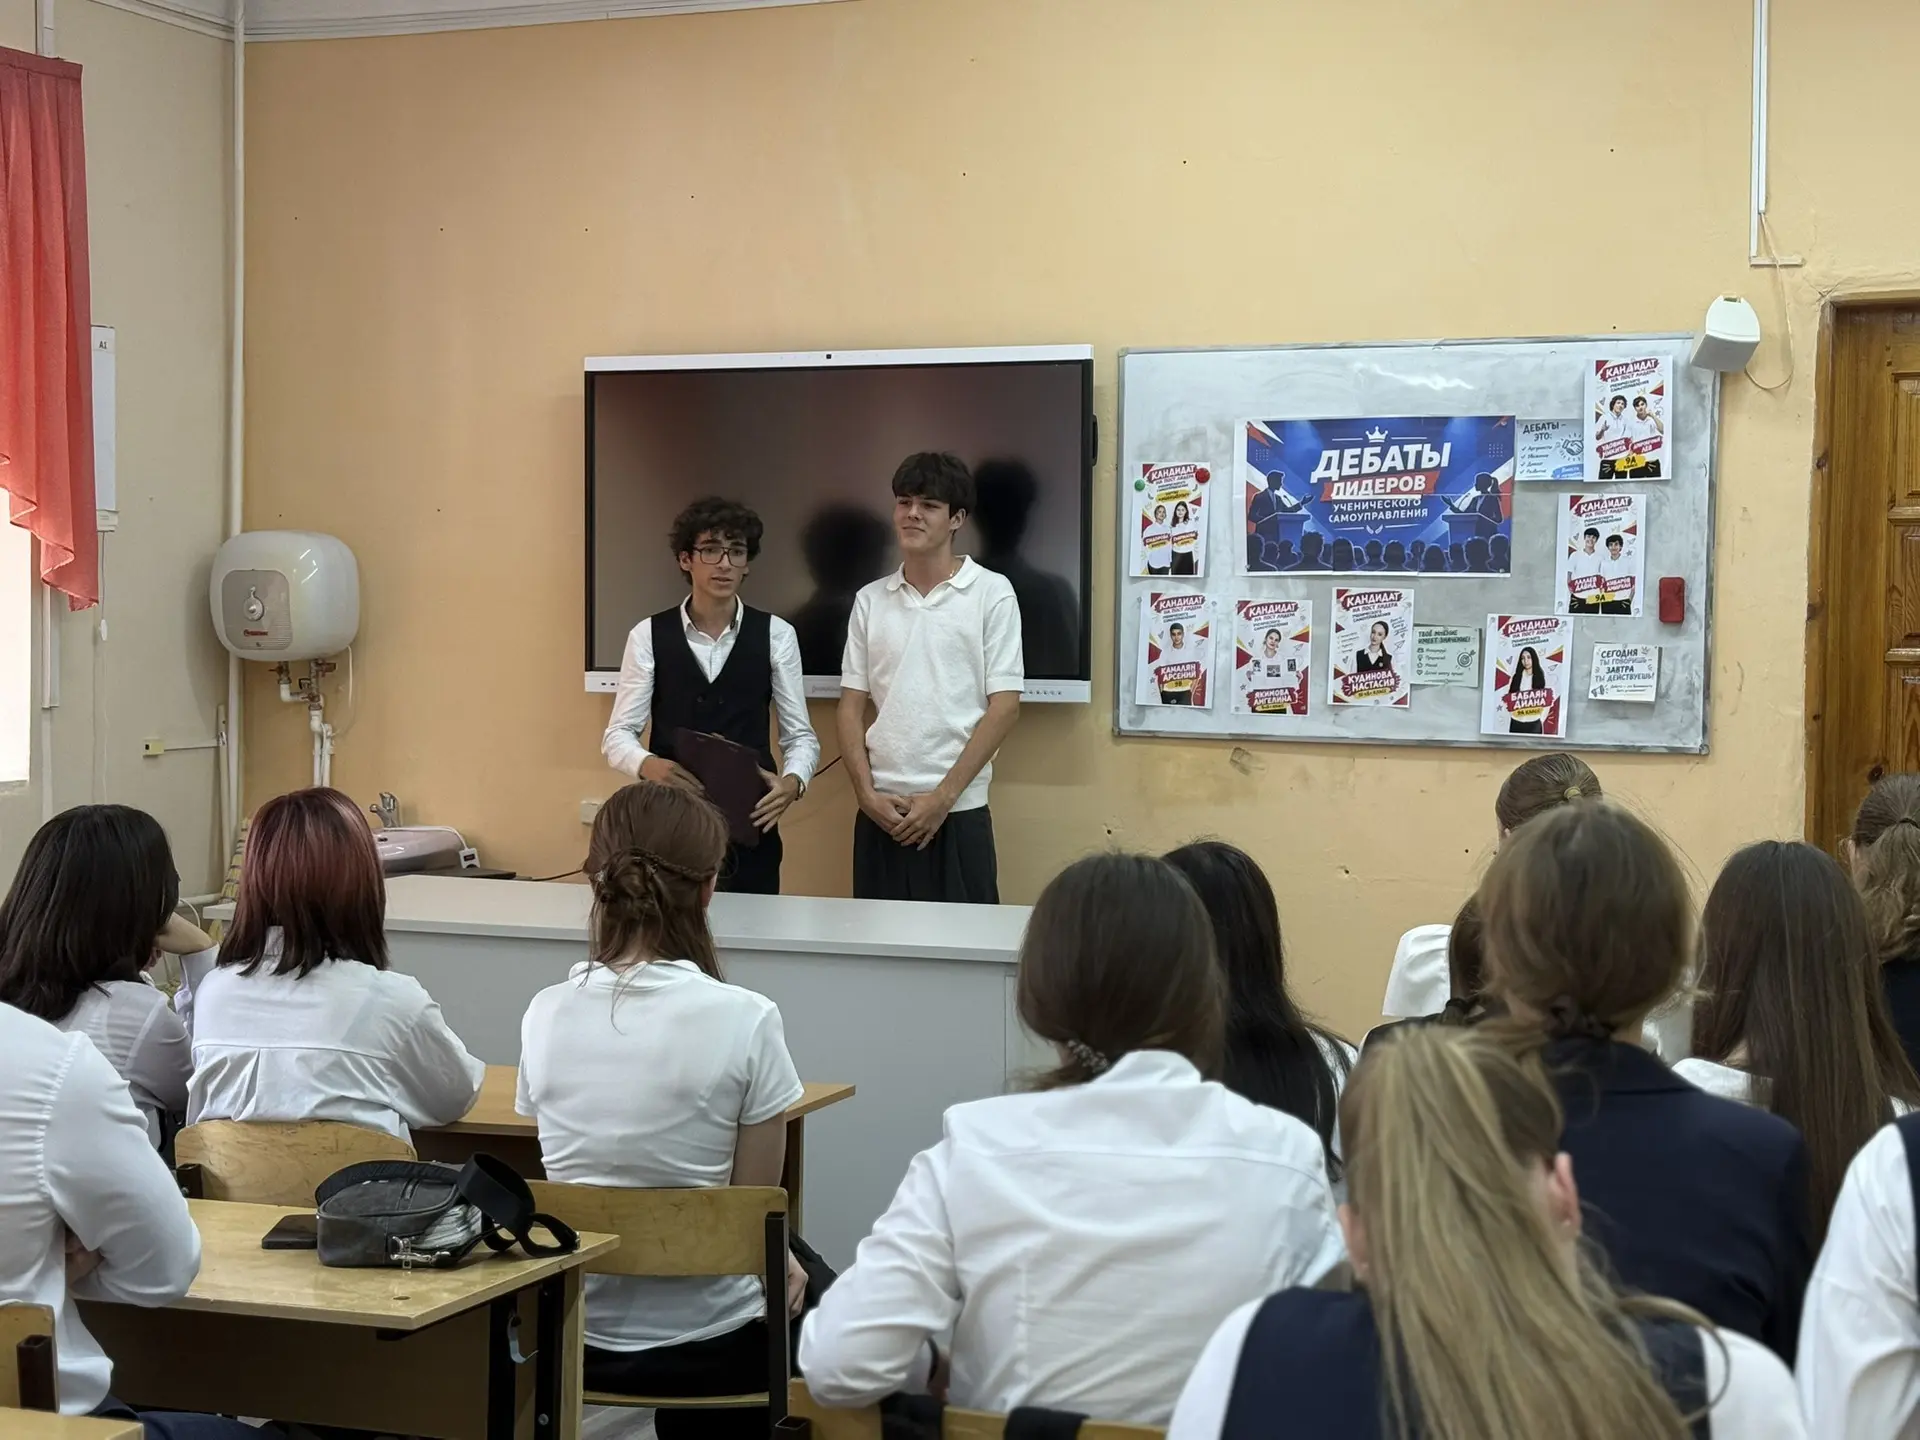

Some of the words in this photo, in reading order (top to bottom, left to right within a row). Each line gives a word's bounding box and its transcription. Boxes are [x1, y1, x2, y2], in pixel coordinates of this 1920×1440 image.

[1606, 359, 1656, 379] КАНДИДАТ
[1523, 421, 1559, 434] ДЕБАТЫ
[1533, 432, 1552, 441] ЭТО:
[1310, 442, 1452, 483] ДЕБАТЫ
[1626, 456, 1637, 465] 9А
[1151, 464, 1195, 481] КАНДИДАТ
[1331, 475, 1426, 498] ЛИДЕРОВ
[1333, 499, 1421, 513] УЧЕНИЧЕСКОГО
[1580, 497, 1630, 514] КАНДИДАТ
[1328, 508, 1428, 523] САМОУПРАВЛЕНИЯ
[1160, 596, 1203, 610] КАНДИДАТ
[1347, 592, 1399, 608] КАНДИДАТ
[1249, 603, 1296, 617] КАНДИДАТ
[1508, 619, 1556, 634] КАНДИДАТ
[1601, 648, 1638, 659] СЕГОДНЯ
[1611, 656, 1647, 665] ГОВОРИШЬ
[1160, 663, 1196, 675] КАМАЛЯН
[1606, 665, 1634, 674] ЗАВТРА
[1348, 670, 1392, 684] КУДИНОВА
[1352, 678, 1395, 691] НАСТАСИЯ
[1253, 695, 1292, 706] АНГЕЛИНА
[1511, 690, 1547, 702] БАБАЯН
[1513, 698, 1546, 710] ДИАНА
